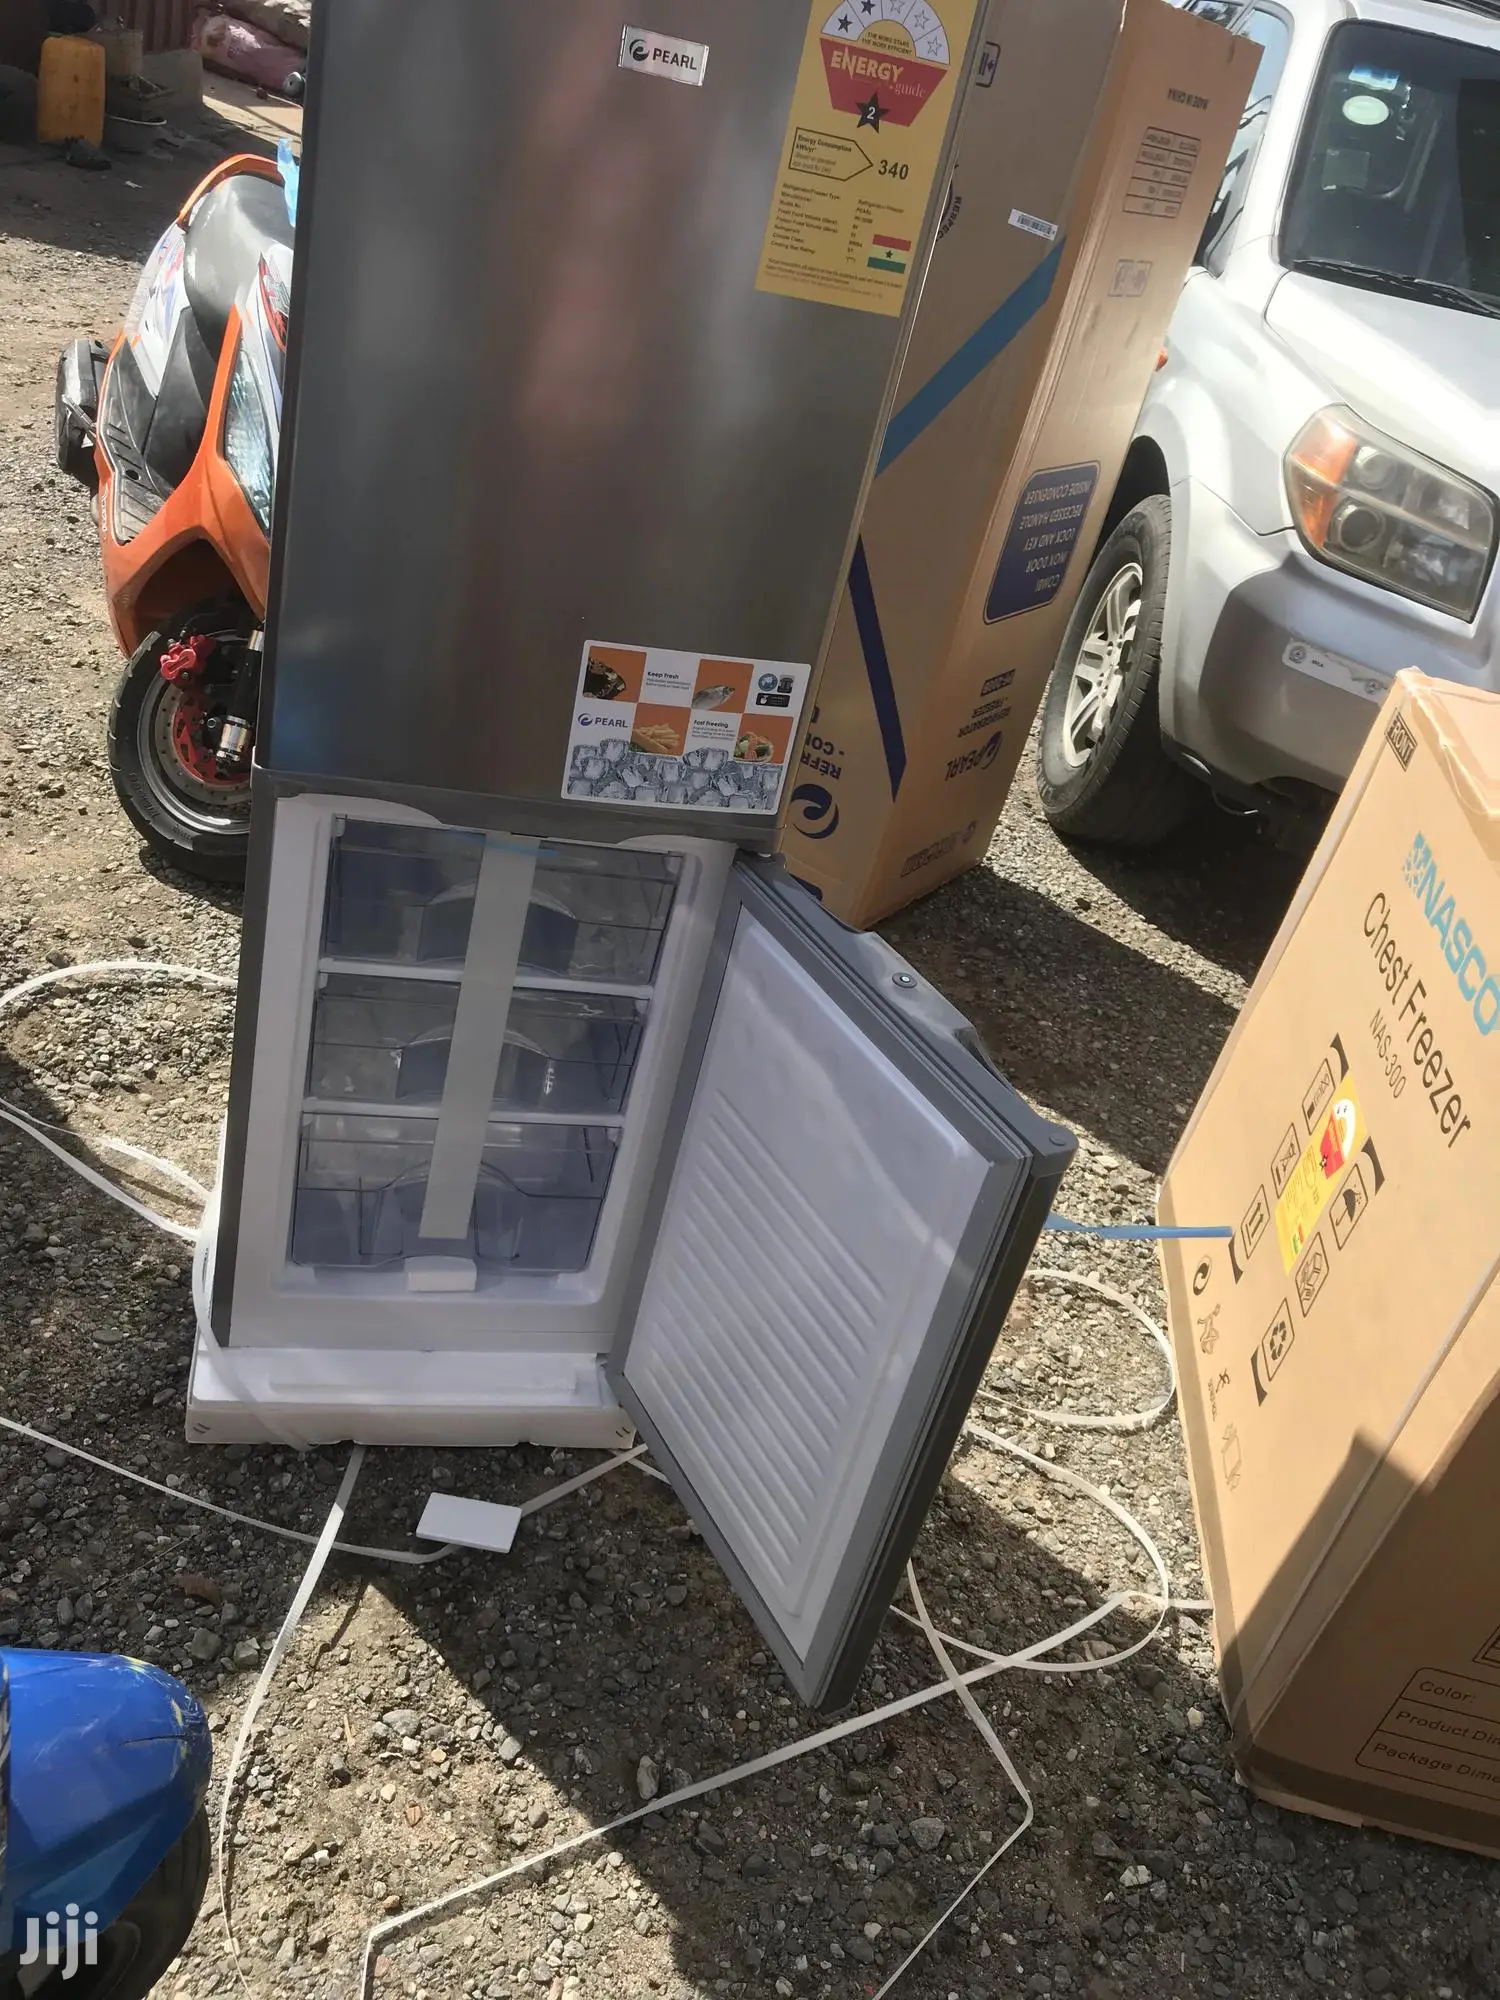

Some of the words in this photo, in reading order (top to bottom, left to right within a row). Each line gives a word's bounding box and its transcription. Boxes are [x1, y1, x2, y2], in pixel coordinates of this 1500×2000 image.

[652, 48, 697, 70] PEARL
[830, 46, 905, 83] ENERGY
[895, 83, 925, 98] guide
[867, 107, 876, 119] 2
[878, 159, 909, 180] 340
[648, 671, 663, 679] Keep
[595, 717, 628, 728] PEARL
[944, 746, 984, 782] PEARL
[1416, 860, 1500, 1036] NASCO
[1364, 893, 1413, 1005] Chest
[1399, 979, 1471, 1148] Freezer
[1369, 1009, 1407, 1098] NAS-300
[1419, 1681, 1476, 1703] Color:
[1396, 1711, 1469, 1737] Product
[1373, 1743, 1452, 1770] Package
